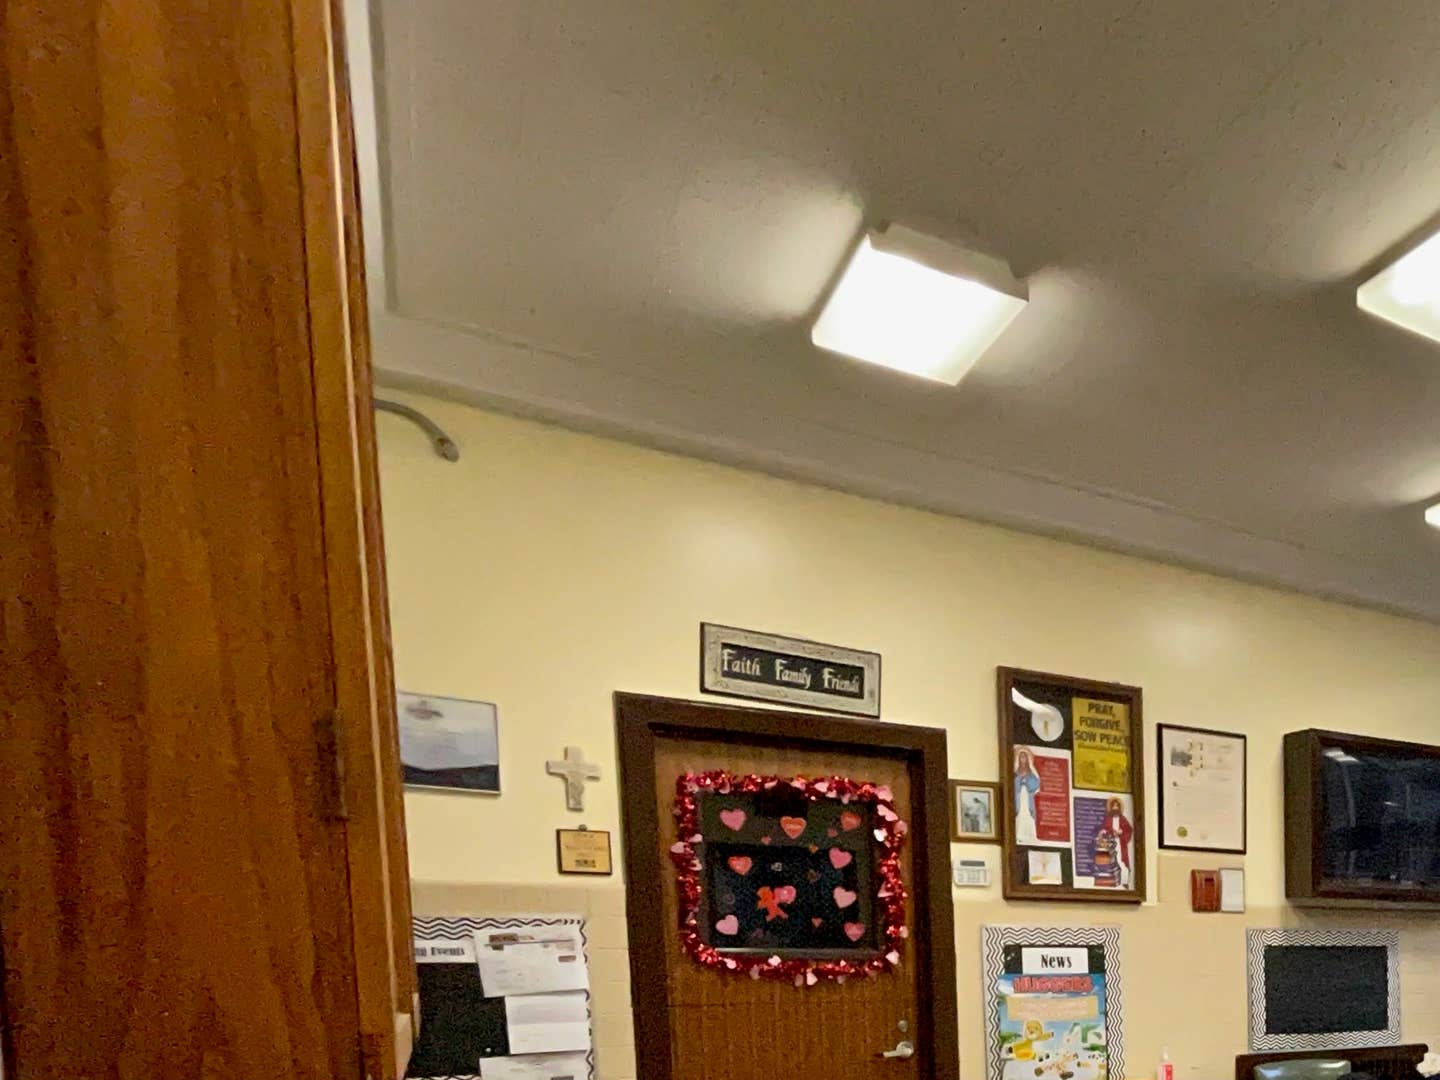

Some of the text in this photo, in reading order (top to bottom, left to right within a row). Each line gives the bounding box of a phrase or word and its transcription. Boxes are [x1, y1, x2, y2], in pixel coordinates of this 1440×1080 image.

[722, 648, 762, 676] Faith
[774, 658, 812, 689] Family
[1040, 954, 1073, 969] News
